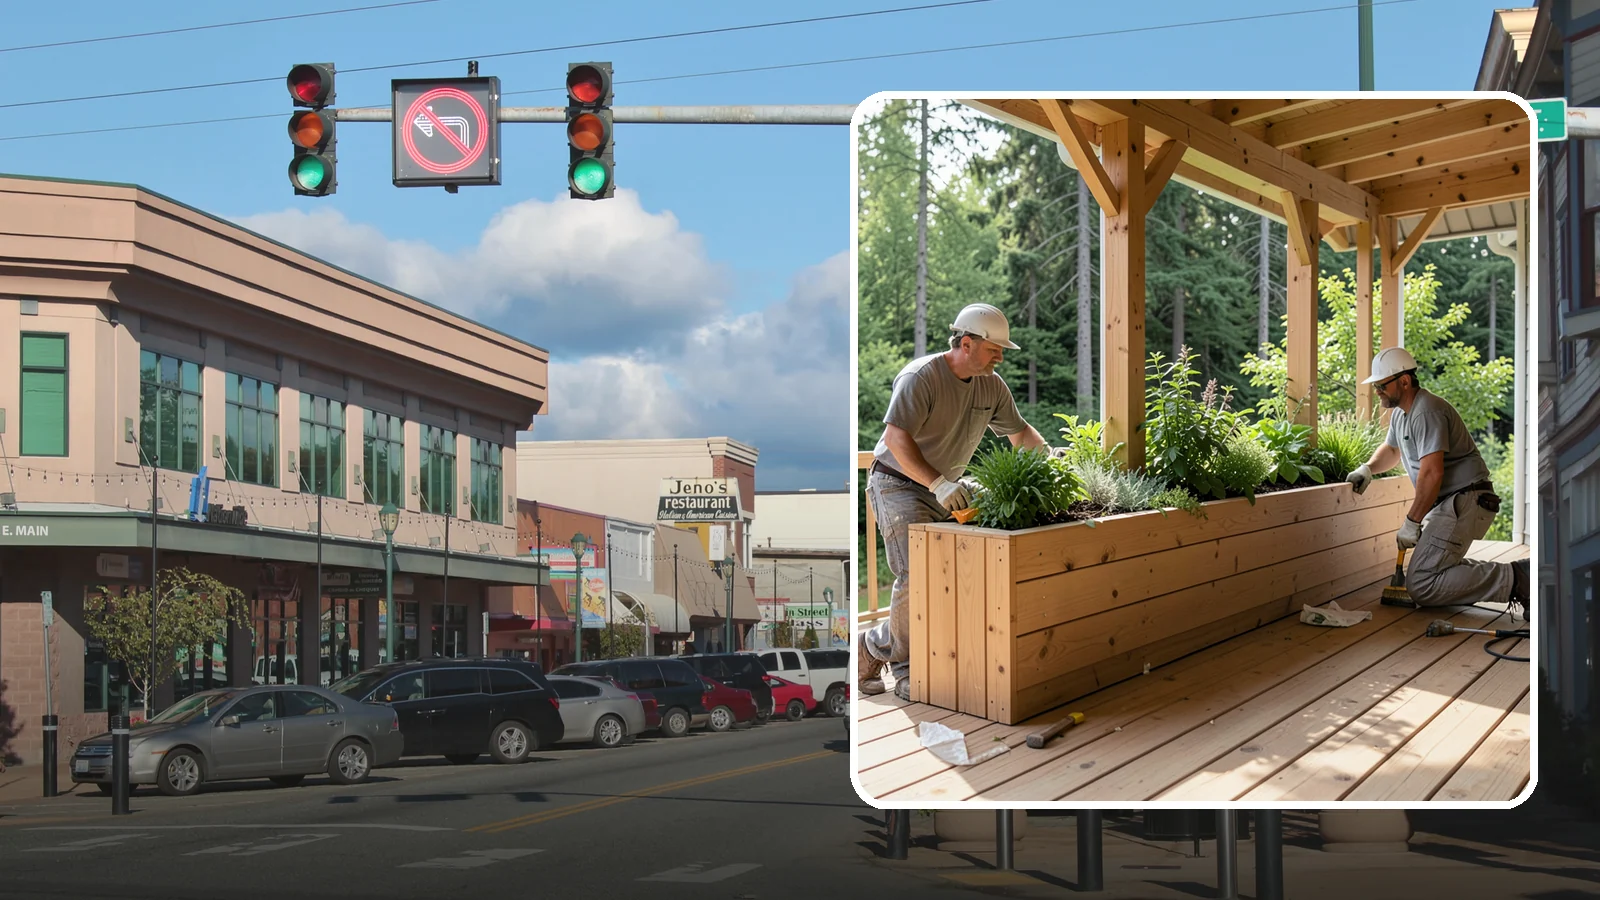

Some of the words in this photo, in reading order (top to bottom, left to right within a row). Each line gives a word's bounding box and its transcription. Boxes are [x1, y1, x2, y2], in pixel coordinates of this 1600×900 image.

[669, 480, 727, 495] Jeno's
[665, 496, 731, 509] restaurant
[686, 509, 714, 519] American
[715, 509, 737, 519] Cuisine
[2, 525, 13, 536] E.
[15, 525, 49, 537] MAIN
[797, 607, 828, 616] Street
